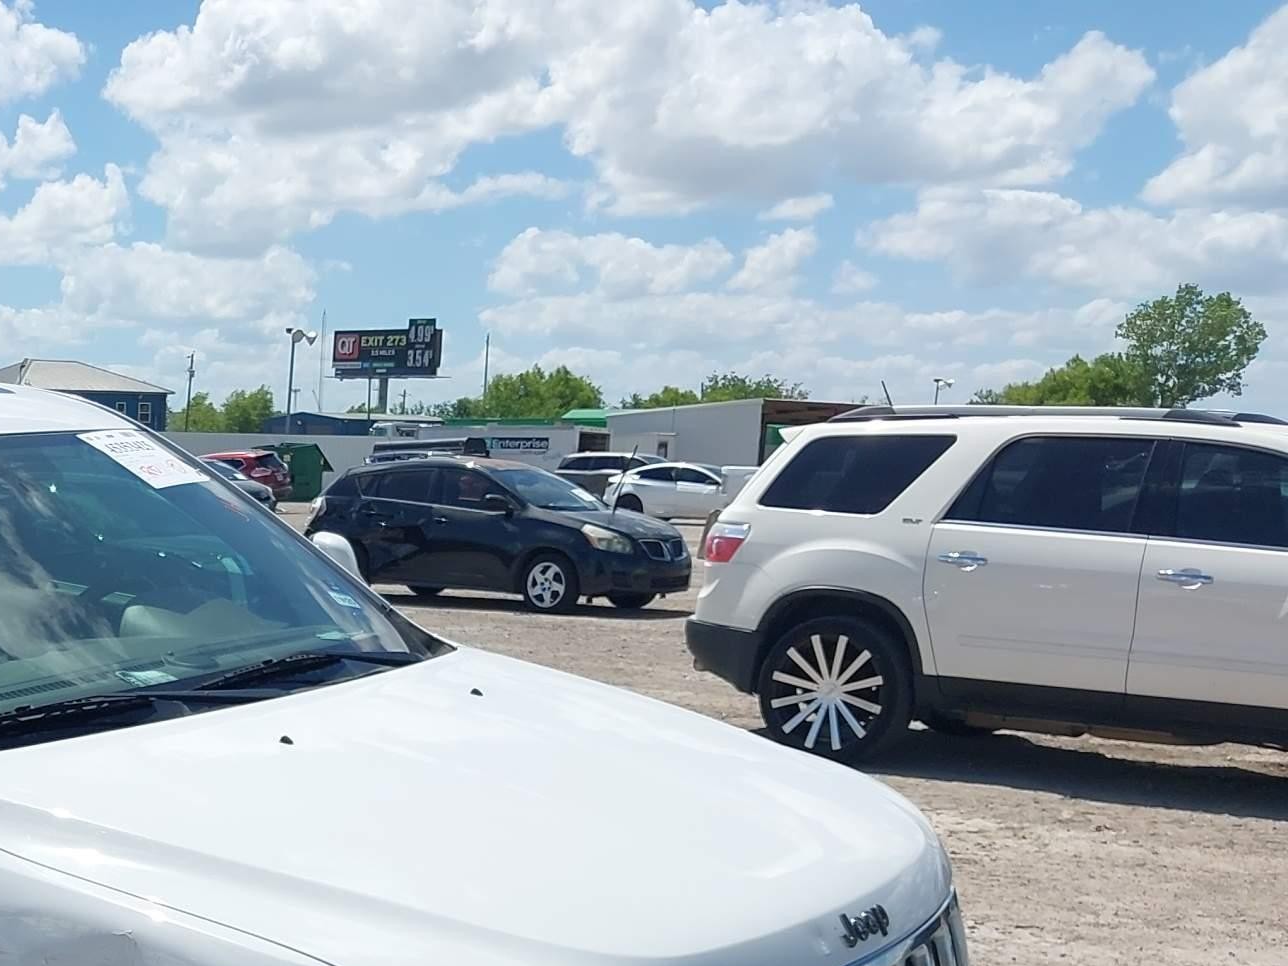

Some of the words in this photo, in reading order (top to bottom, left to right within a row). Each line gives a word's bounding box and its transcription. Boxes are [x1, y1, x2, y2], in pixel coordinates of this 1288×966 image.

[337, 337, 355, 354] QT
[361, 336, 385, 347] EXIT
[386, 335, 407, 347] 273
[492, 438, 548, 449] Enterprise
[839, 904, 889, 948] Jeep
